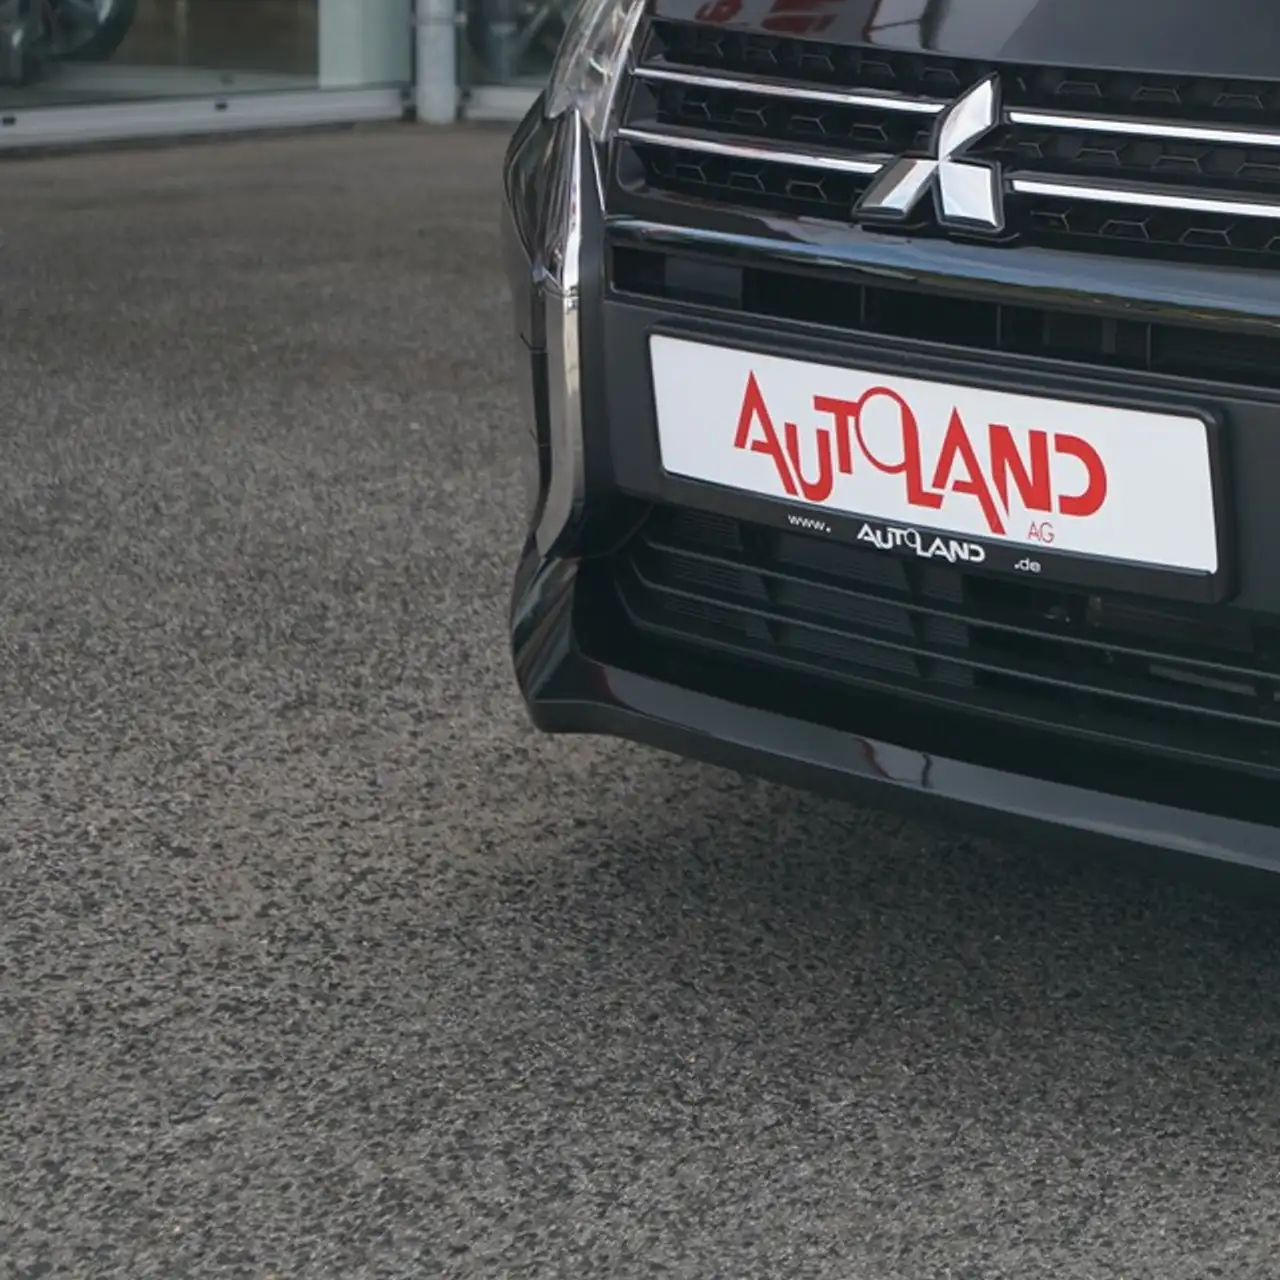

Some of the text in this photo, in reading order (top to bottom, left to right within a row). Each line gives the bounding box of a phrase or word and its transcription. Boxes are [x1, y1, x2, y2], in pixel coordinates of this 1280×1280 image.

[734, 369, 1107, 535] AUTOLAND
[787, 514, 1042, 573] www. AUTOLAND .de
[1027, 521, 1055, 543] AG
